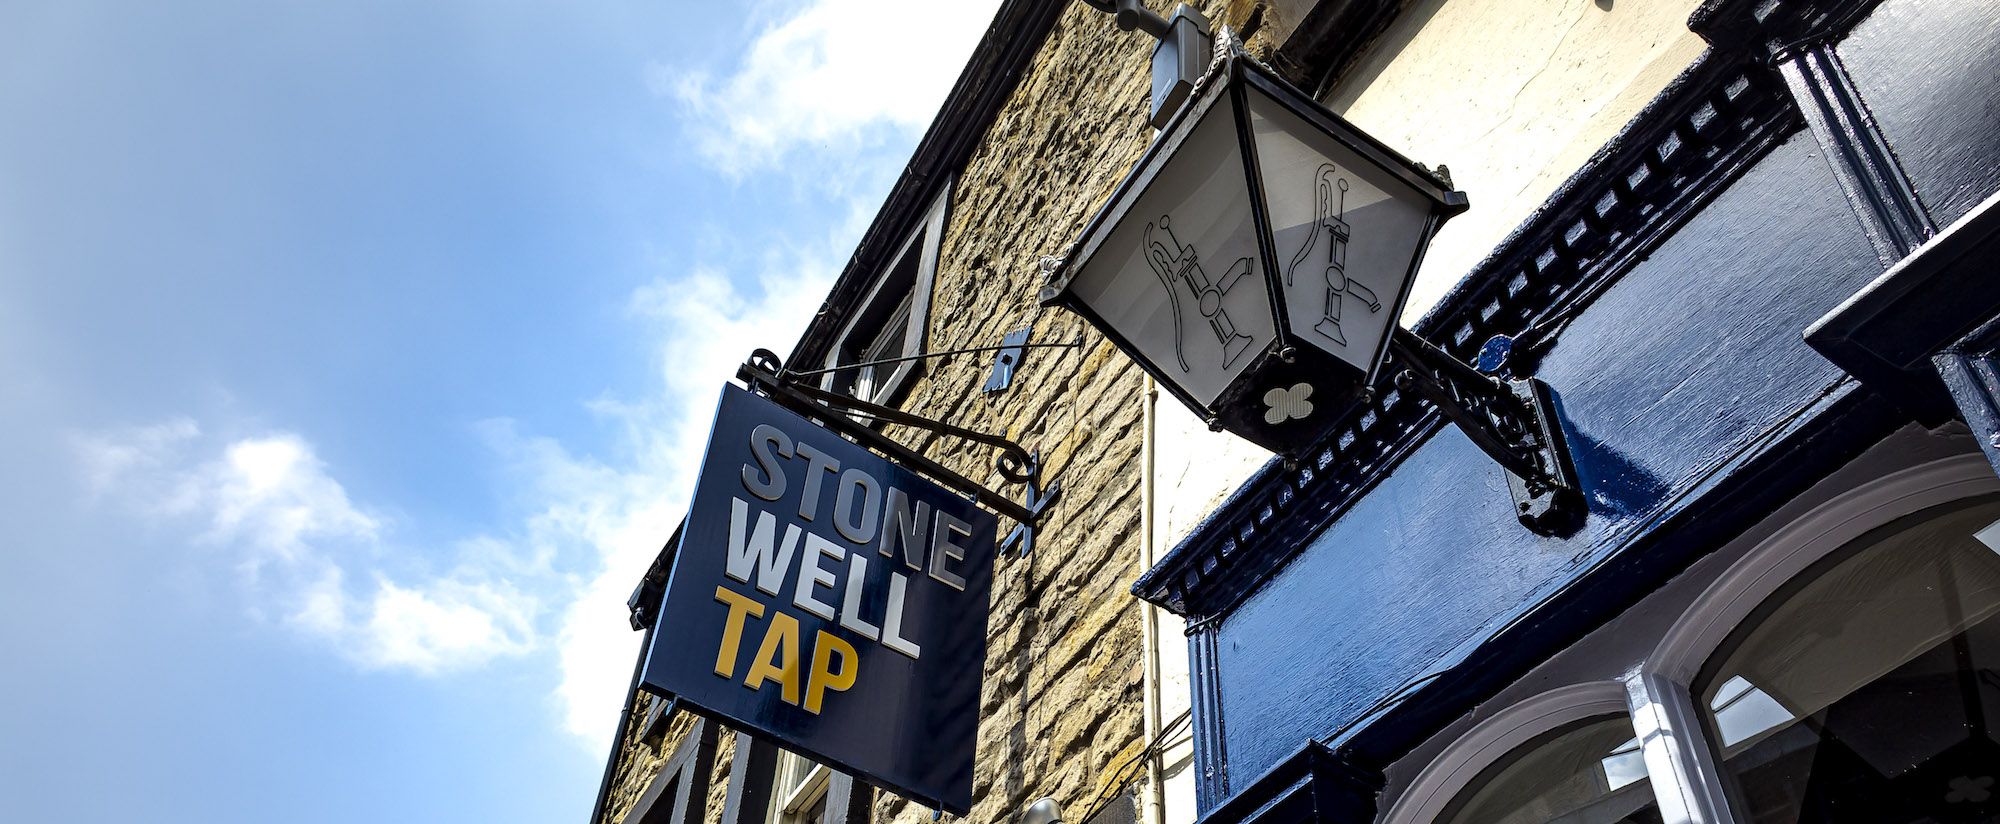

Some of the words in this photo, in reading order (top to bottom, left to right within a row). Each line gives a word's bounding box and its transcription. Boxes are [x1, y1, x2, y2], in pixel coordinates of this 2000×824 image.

[724, 496, 921, 659] WELL
[741, 423, 973, 591] STONE
[713, 585, 859, 715] TAP
